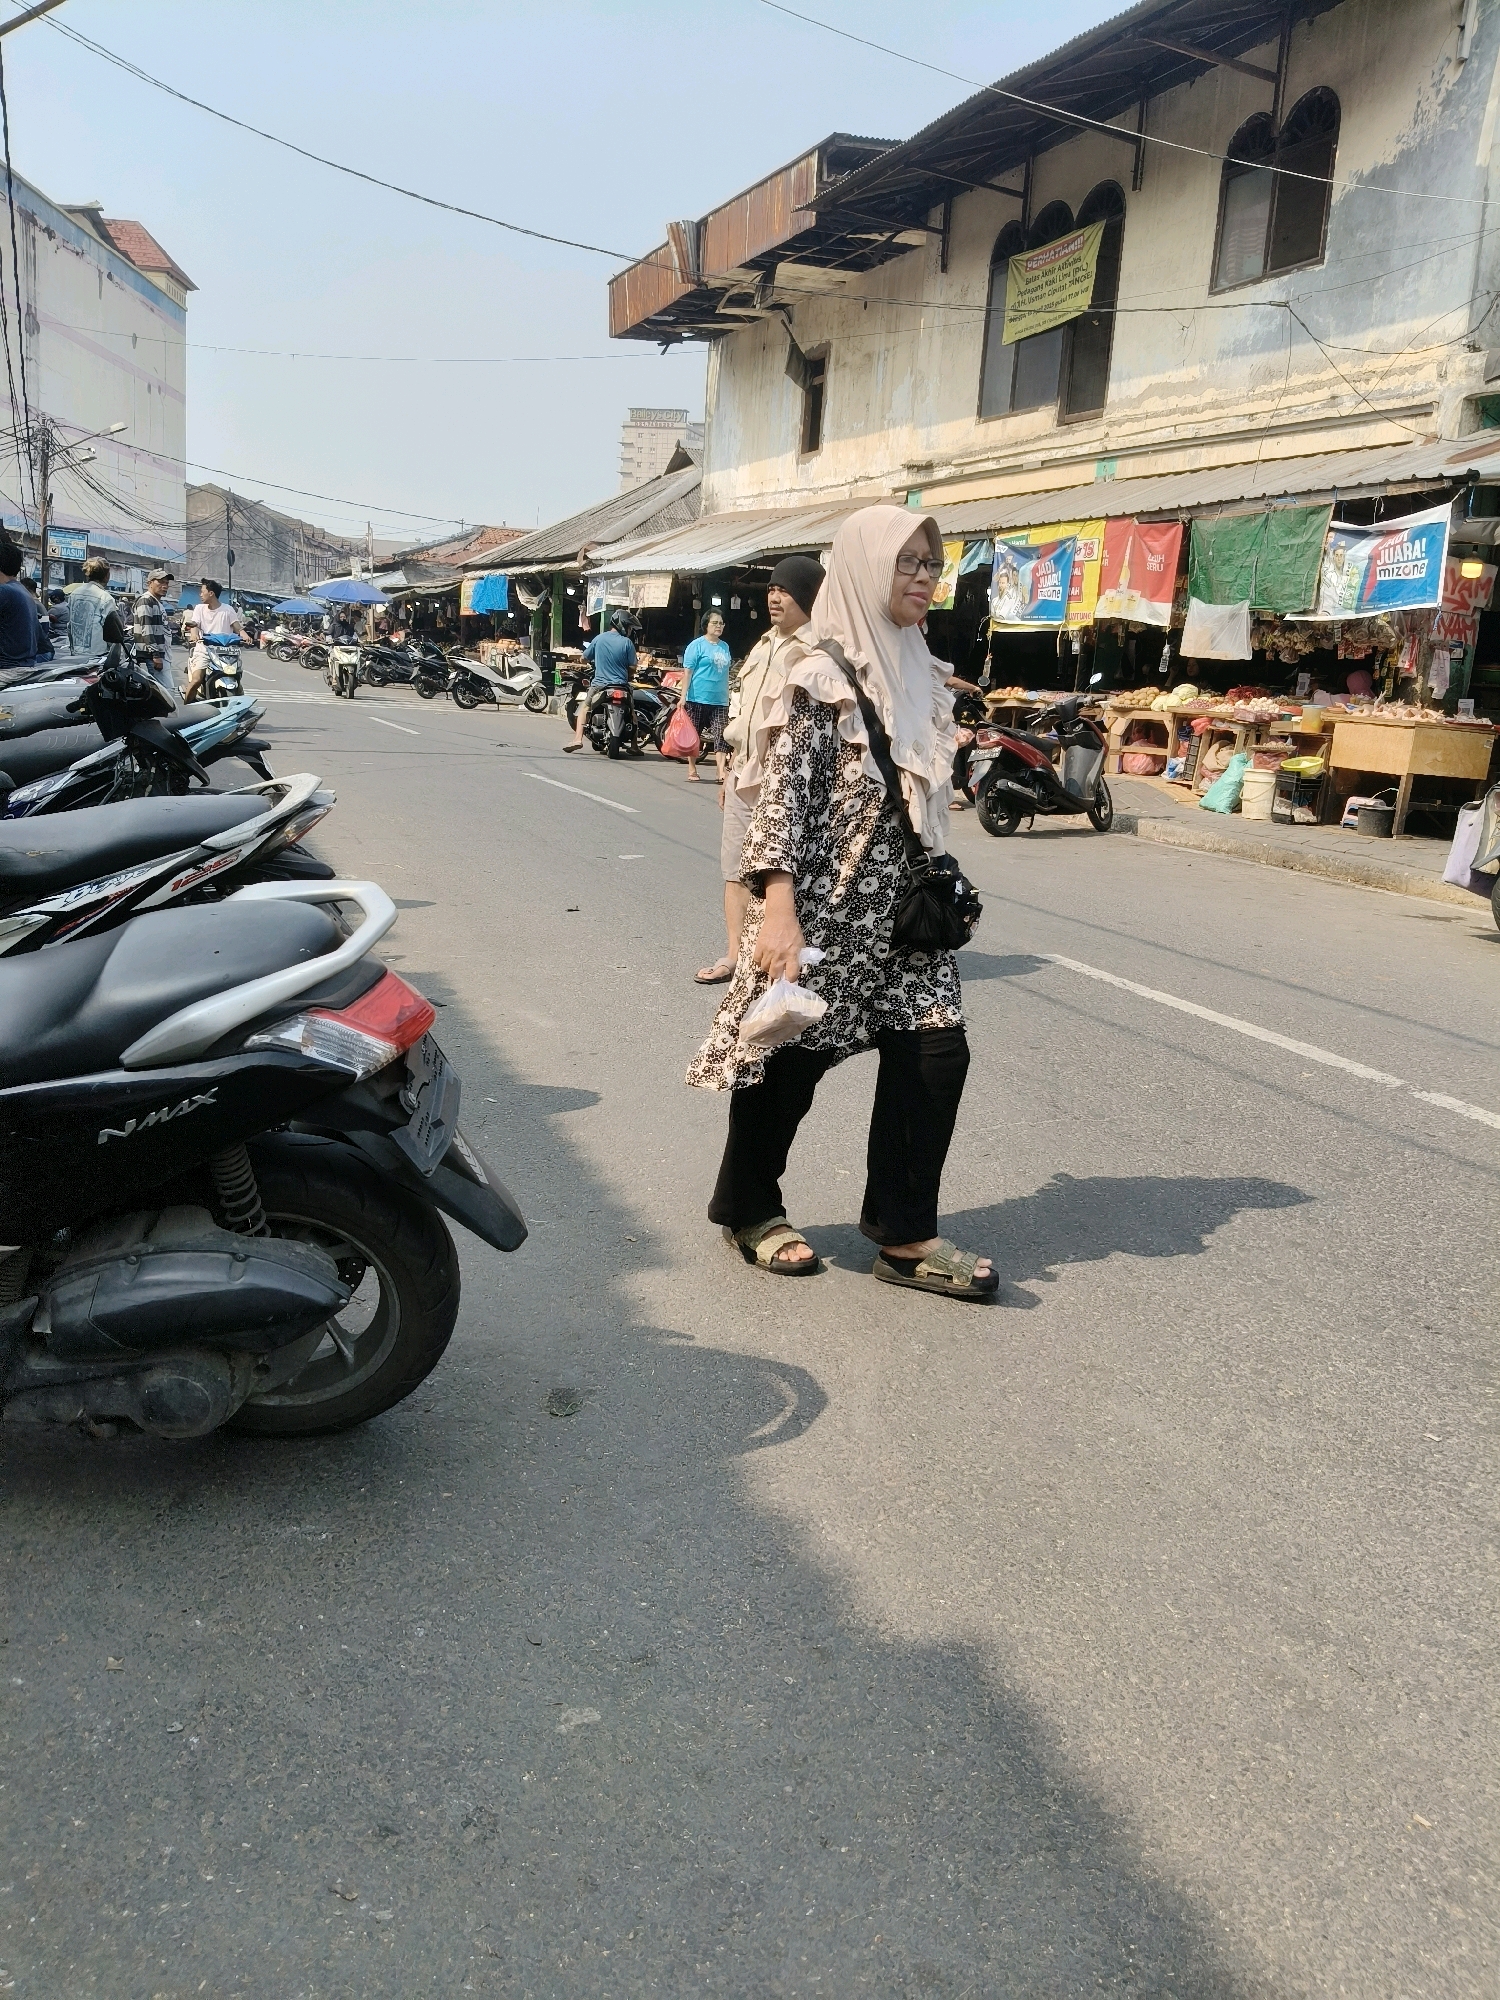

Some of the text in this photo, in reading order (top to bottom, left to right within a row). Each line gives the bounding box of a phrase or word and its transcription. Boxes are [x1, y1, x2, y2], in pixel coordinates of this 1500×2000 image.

[1027, 235, 1084, 271] PERHATIAN!!!
[1041, 266, 1056, 279] Akhir
[1017, 283, 1043, 297] Pedagang
[1045, 276, 1058, 288] Kaki
[1058, 271, 1071, 282] Lima
[1028, 292, 1046, 305] Usman
[1047, 283, 1067, 298] Ciputat
[664, 410, 684, 423] City
[61, 547, 85, 558] MASUK
[1376, 537, 1427, 566] JUARA!
[1036, 559, 1055, 577] JADI
[1146, 561, 1164, 572] SERU
[1378, 562, 1426, 578] mizone
[98, 1086, 219, 1145] NMAX
